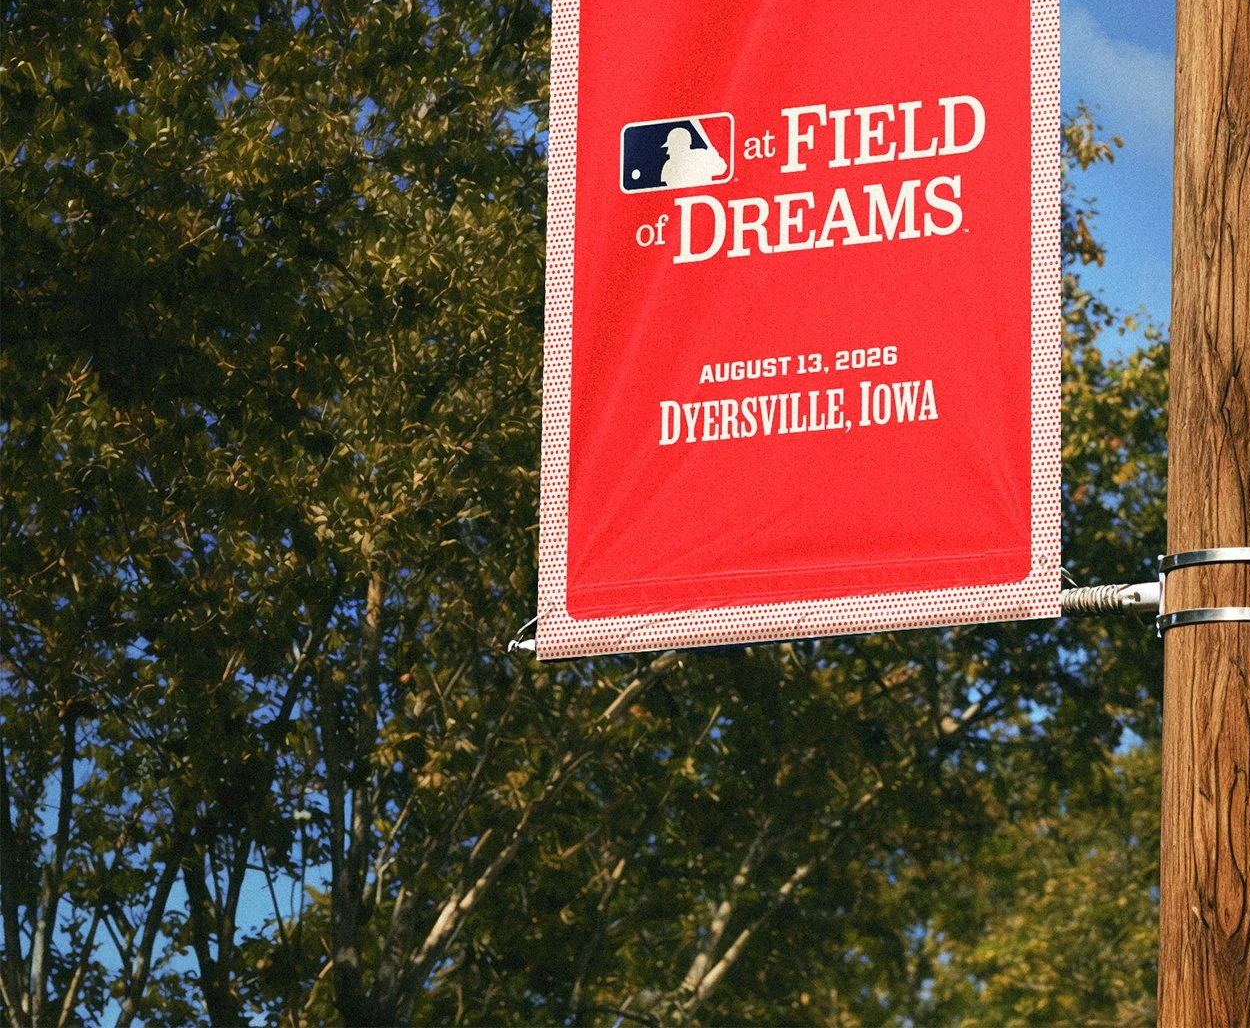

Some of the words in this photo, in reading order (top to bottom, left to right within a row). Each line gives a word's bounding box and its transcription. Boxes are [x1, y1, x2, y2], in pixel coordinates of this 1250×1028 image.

[743, 128, 777, 160] at
[780, 95, 986, 174] FIELD
[635, 214, 670, 248] of
[672, 174, 964, 265] DREAMS
[699, 356, 792, 384] AUGUST
[796, 353, 830, 375] 13,
[835, 345, 898, 371] 2026
[658, 387, 853, 446] DYERSVILLE,
[859, 378, 939, 428] IOWA
